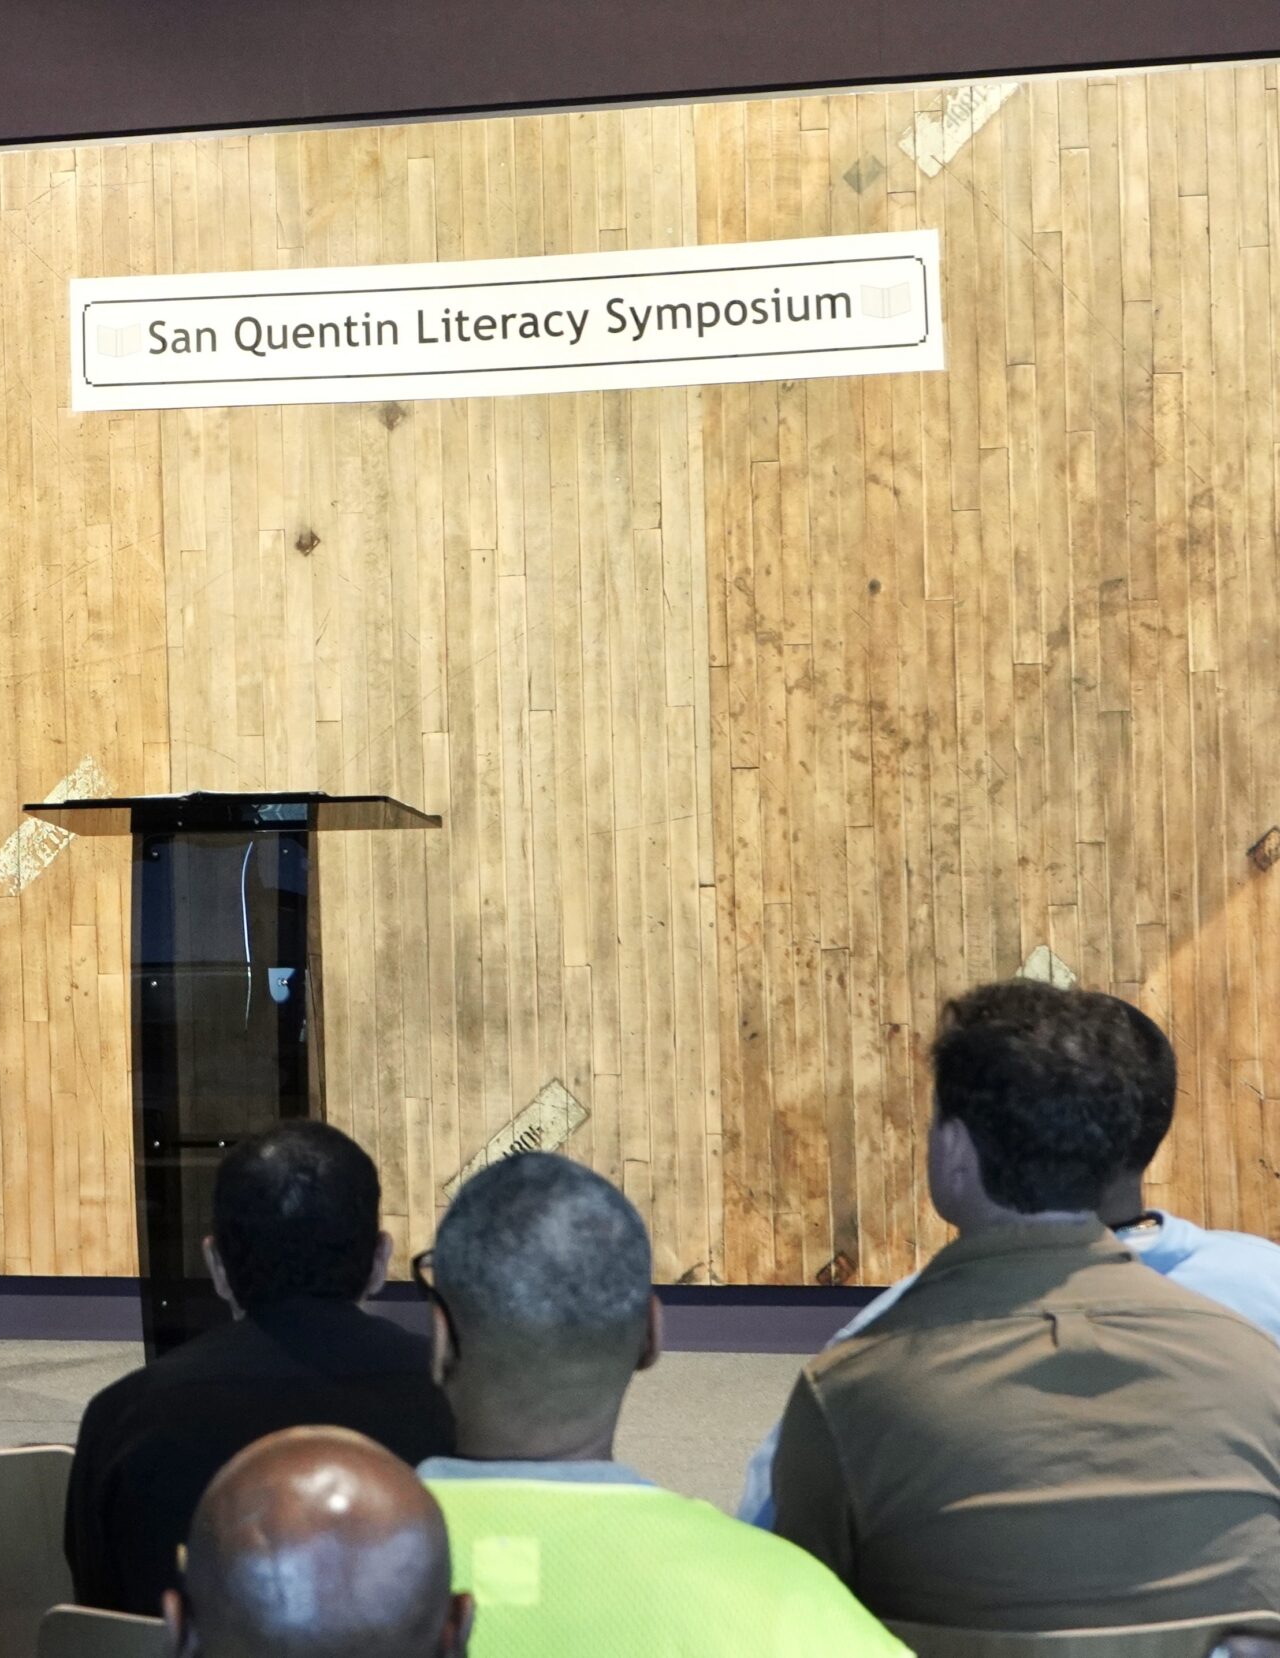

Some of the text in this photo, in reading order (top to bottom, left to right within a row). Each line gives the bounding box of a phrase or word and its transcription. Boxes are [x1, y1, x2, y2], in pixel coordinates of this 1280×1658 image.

[148, 289, 852, 357] San Quentin Literacy Symposium
